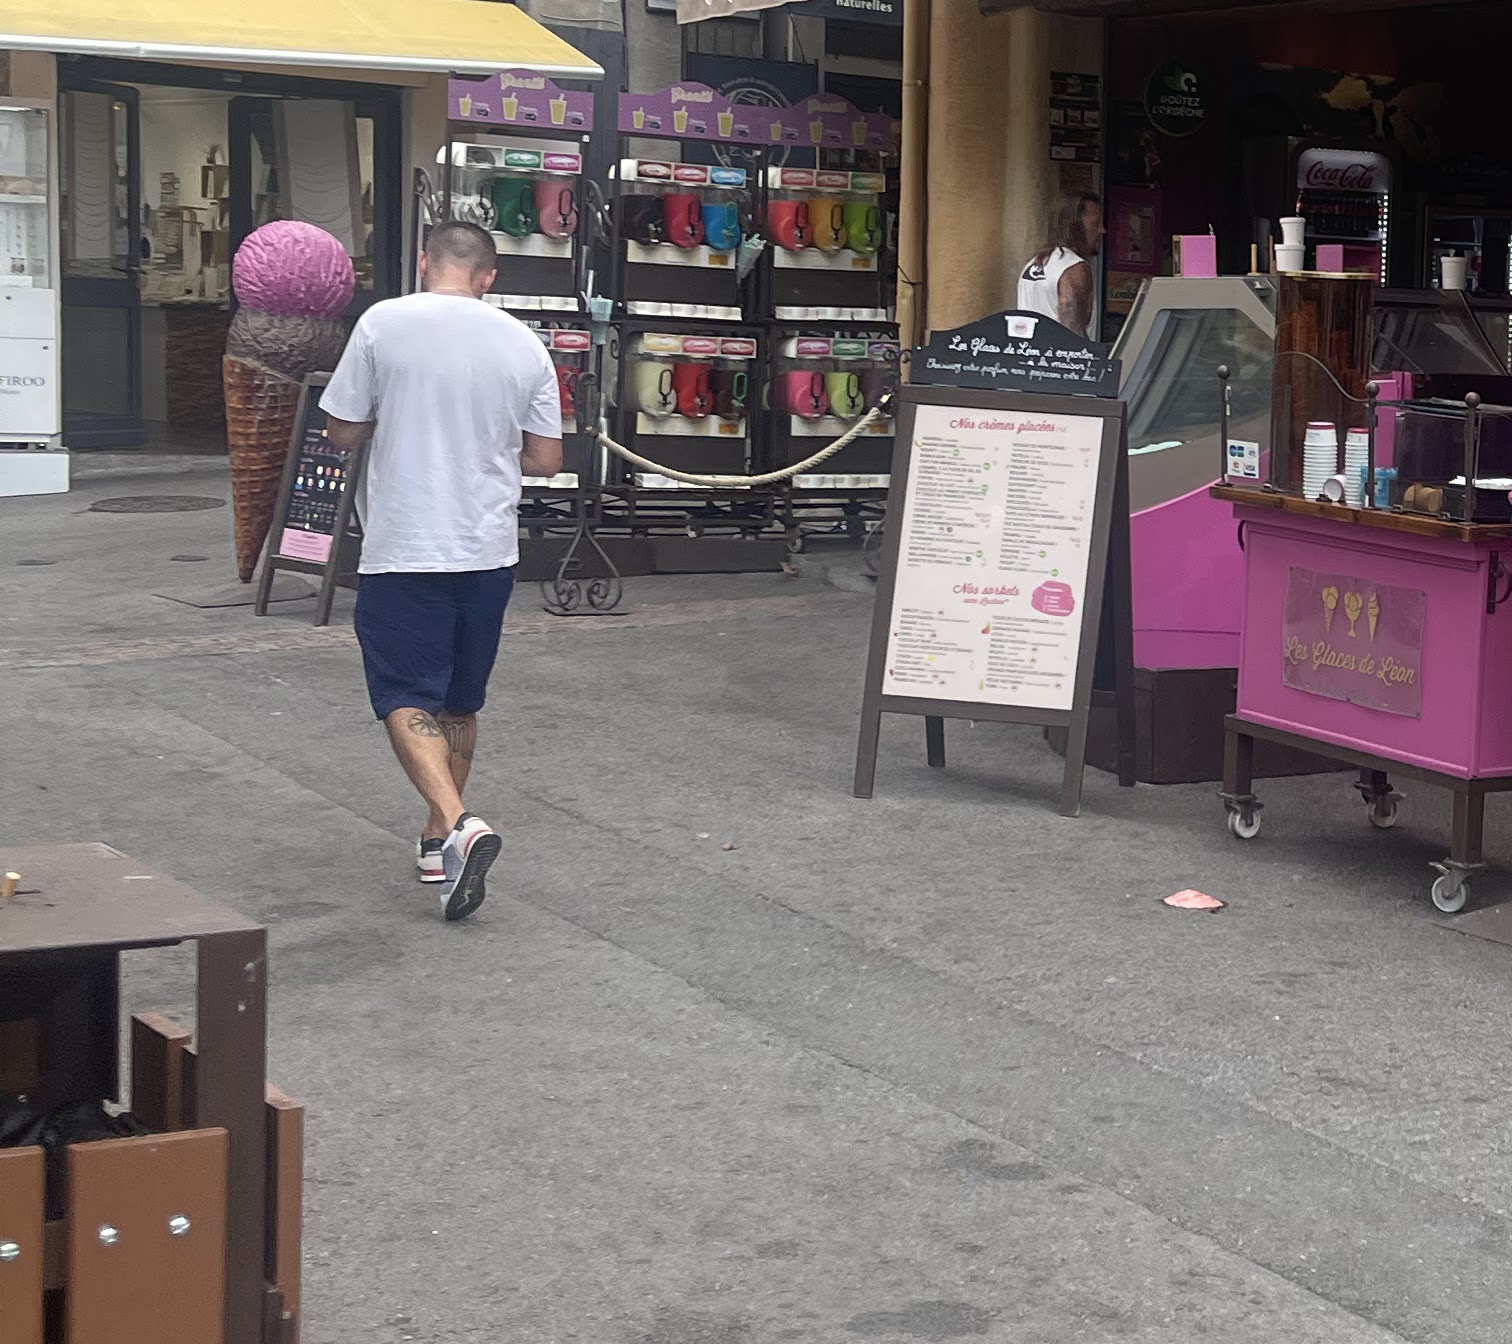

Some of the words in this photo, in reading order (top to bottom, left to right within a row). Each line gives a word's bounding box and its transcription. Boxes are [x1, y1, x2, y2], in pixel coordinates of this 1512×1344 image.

[950, 418, 975, 430] Nos
[978, 418, 1015, 431] crèmes
[1016, 419, 1056, 434] glacées
[952, 582, 979, 595] Nos
[981, 583, 1020, 596] sorbets
[1284, 636, 1308, 665] Les
[1312, 641, 1356, 671] Glaces
[1358, 651, 1375, 675] de
[1377, 655, 1415, 687] Léon
